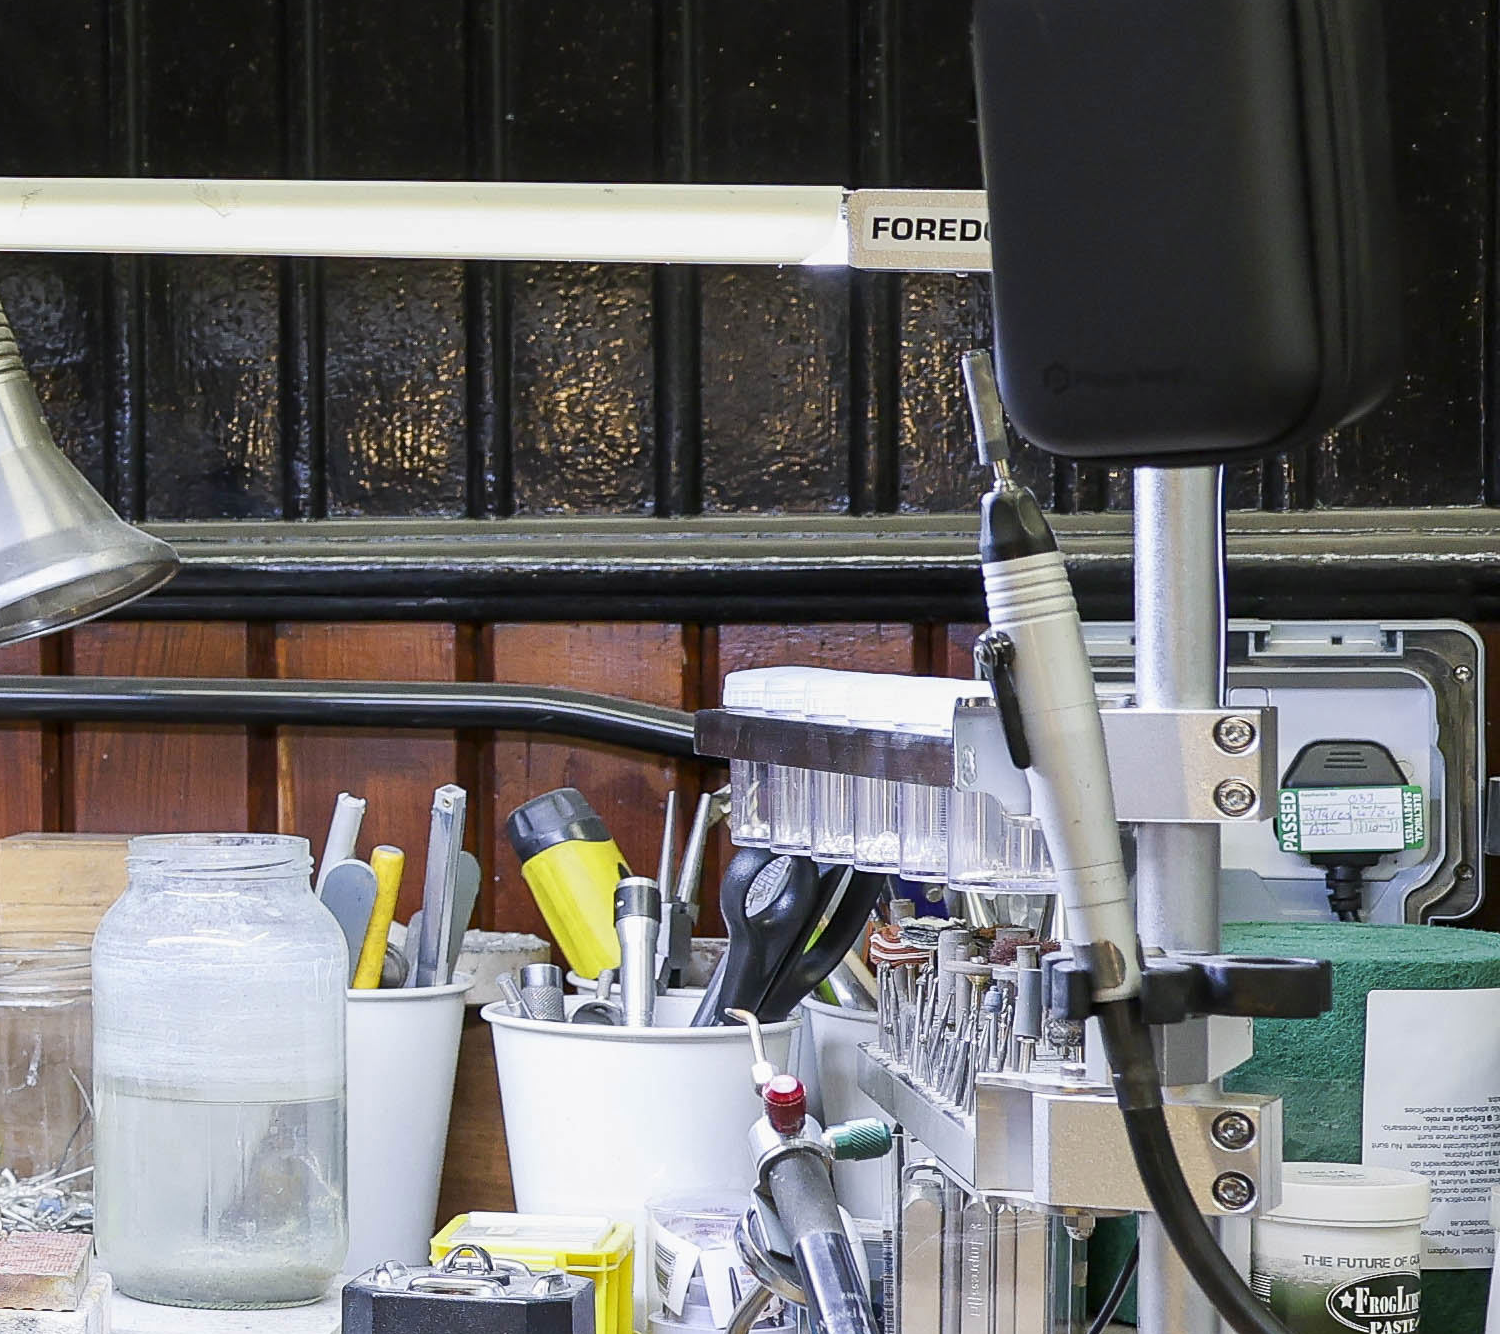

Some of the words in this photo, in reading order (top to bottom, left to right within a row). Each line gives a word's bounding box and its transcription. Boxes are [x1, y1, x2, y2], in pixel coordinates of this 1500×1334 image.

[1403, 791, 1414, 823] SAFETY
[1412, 793, 1424, 843] ELECTRICAL
[1280, 791, 1299, 852] PASSED
[1404, 824, 1414, 844] TEST
[1302, 1254, 1333, 1268] THE
[1337, 1257, 1391, 1269] FUTURE
[1393, 1256, 1408, 1268] OF
[1369, 1318, 1416, 1334] PASTE
